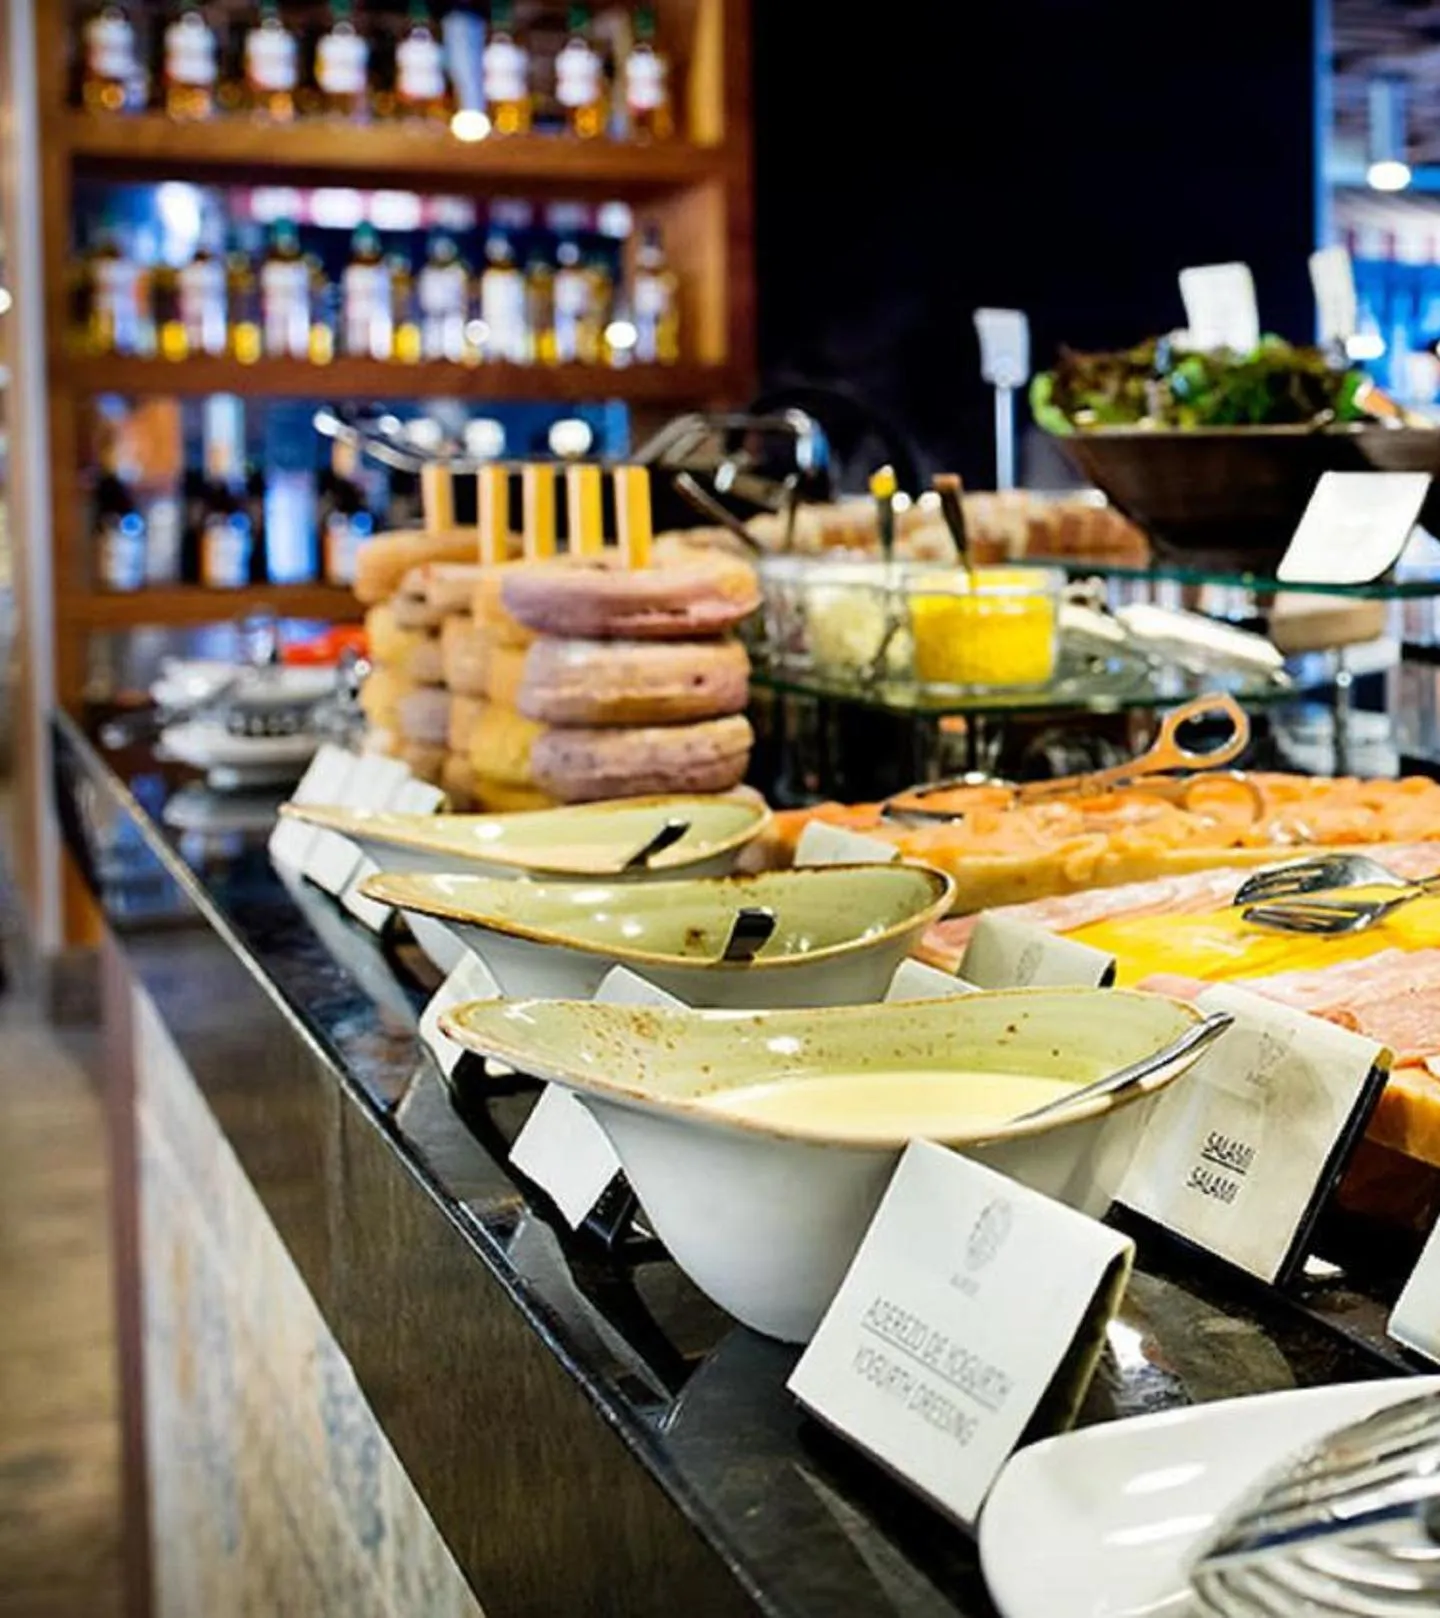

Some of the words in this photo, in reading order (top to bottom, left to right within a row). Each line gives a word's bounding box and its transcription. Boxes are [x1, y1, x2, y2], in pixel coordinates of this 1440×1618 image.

[1204, 1131, 1255, 1168] SALAMI
[1187, 1166, 1239, 1204] SALAMI
[866, 1297, 928, 1351] ADEREZO
[922, 1331, 950, 1364] DE
[907, 1382, 980, 1447] DRESSING
